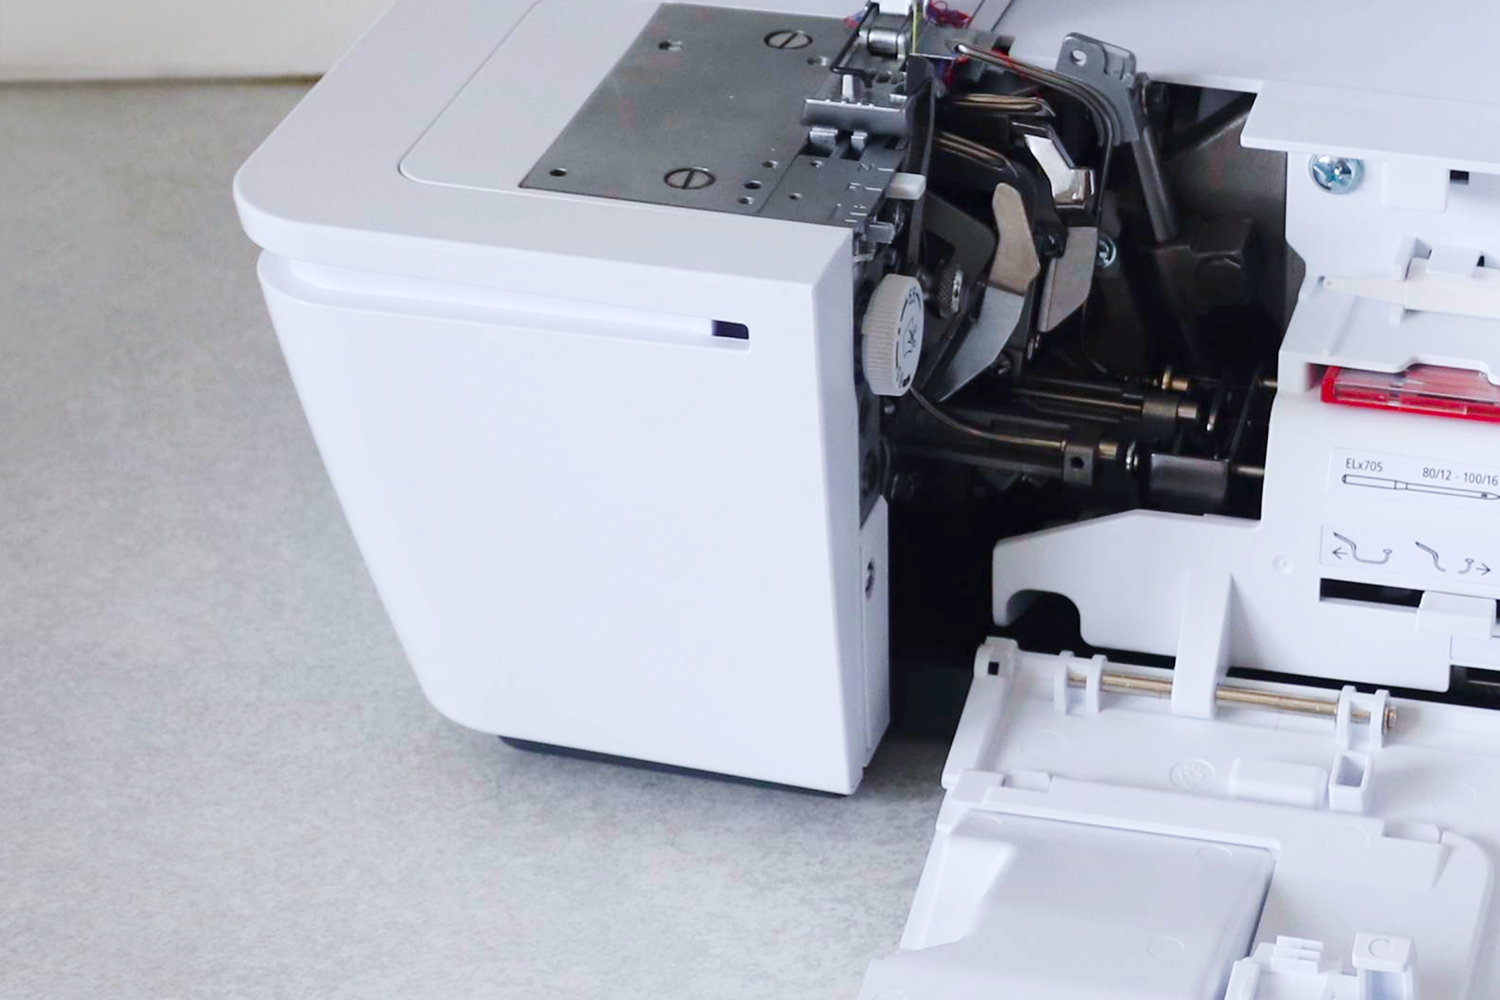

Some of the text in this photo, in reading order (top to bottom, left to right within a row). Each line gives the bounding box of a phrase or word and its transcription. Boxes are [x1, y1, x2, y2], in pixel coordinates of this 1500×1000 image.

[1346, 458, 1382, 472] ELx705
[1423, 467, 1451, 480] 80/12
[1464, 473, 1498, 486] 100/16
